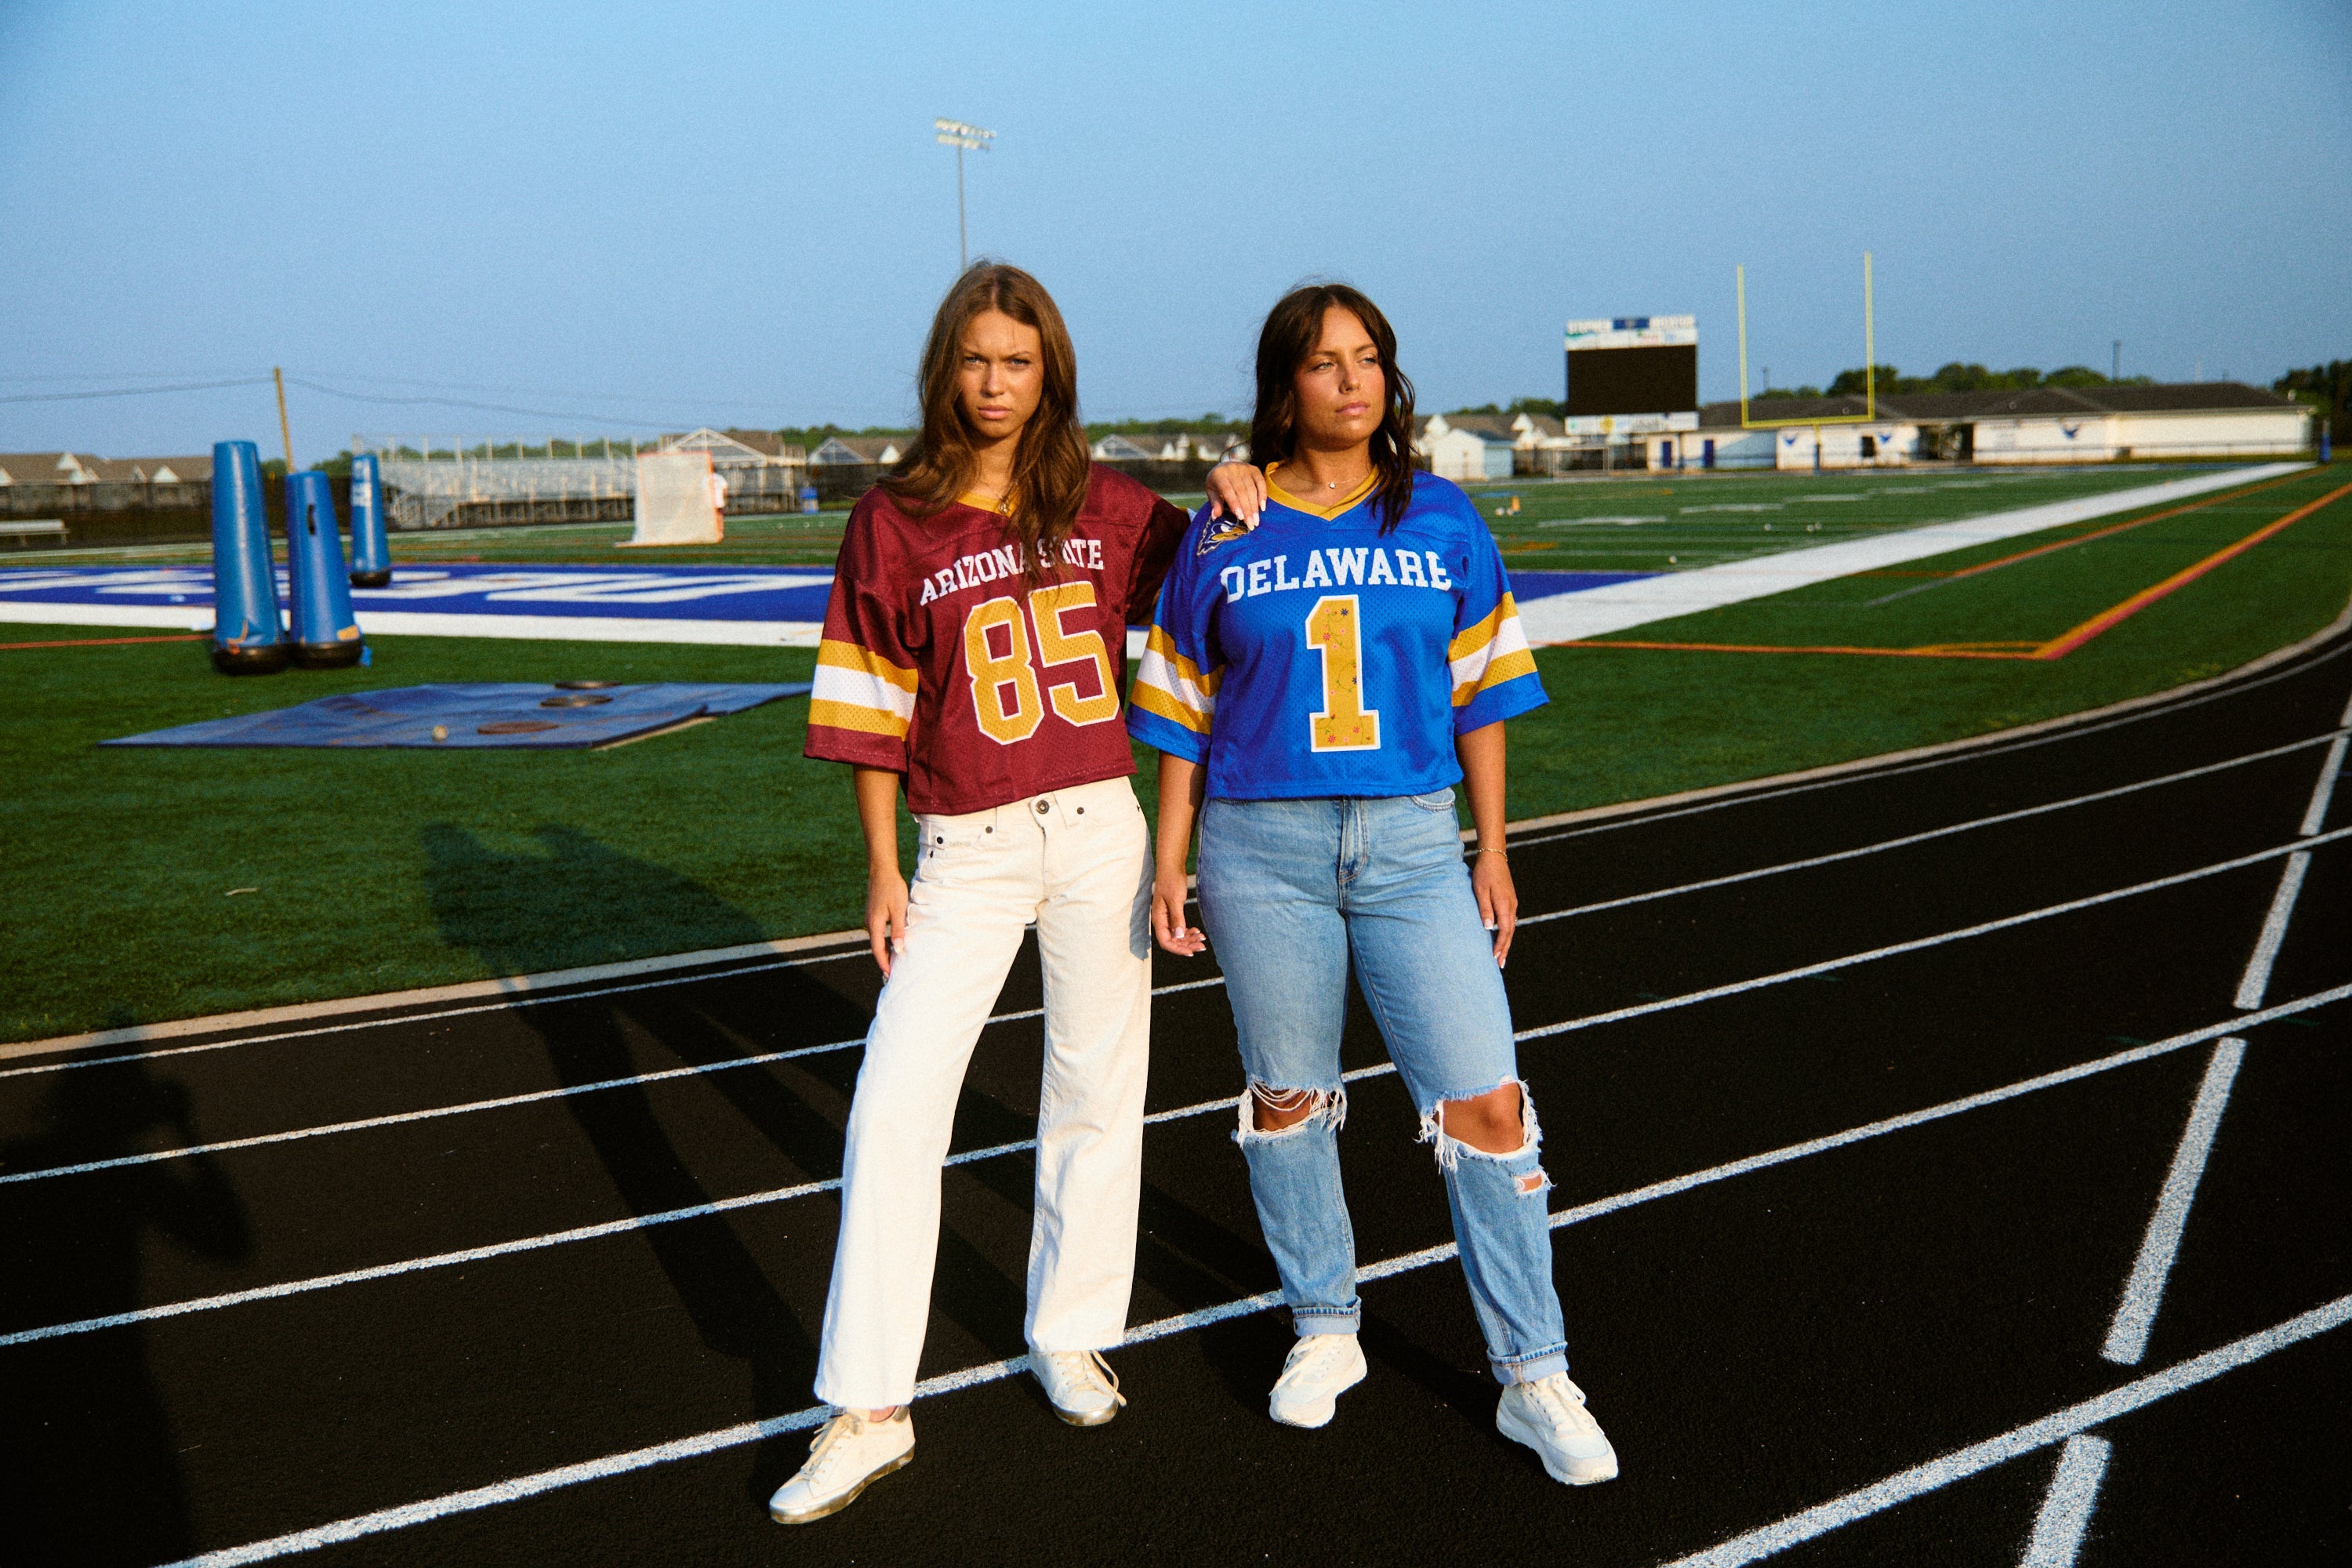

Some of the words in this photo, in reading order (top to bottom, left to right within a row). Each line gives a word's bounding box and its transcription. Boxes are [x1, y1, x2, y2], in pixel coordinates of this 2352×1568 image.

[1037, 536, 1104, 570] SATE
[1220, 547, 1452, 604] DELAWARE
[964, 580, 1120, 746] 85
[1305, 593, 1381, 753] 1
